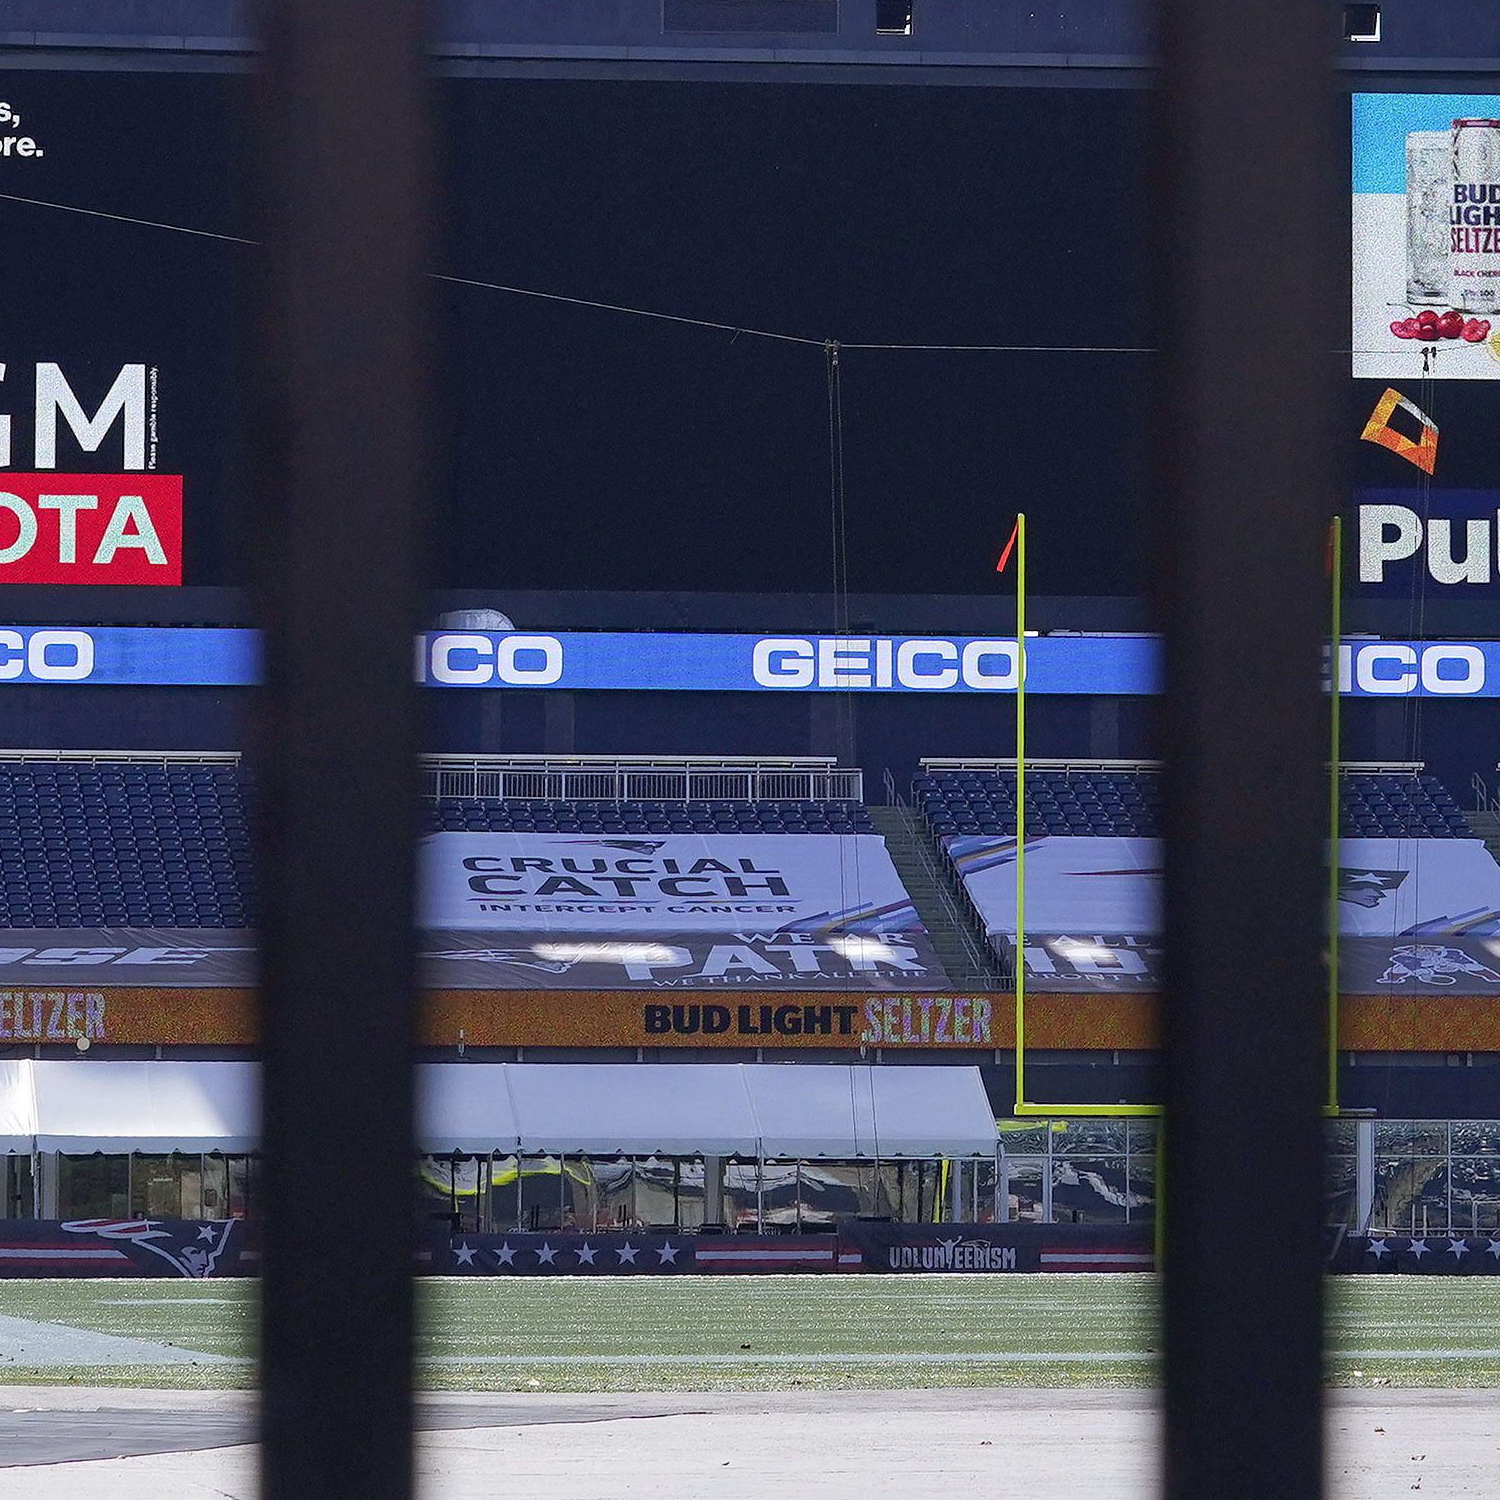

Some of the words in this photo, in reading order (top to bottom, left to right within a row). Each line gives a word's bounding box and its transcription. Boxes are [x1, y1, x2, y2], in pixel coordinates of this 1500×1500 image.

[414, 635, 563, 684] ICO
[752, 638, 1027, 689] GEICO
[1322, 645, 1486, 694] ICO
[462, 856, 781, 875] CRUCIAL
[466, 875, 790, 897] CATCH
[478, 903, 654, 914] INTERCEPT
[666, 904, 796, 914] CANCER
[643, 1005, 732, 1034] BUD
[736, 1005, 857, 1034] LIGHT
[862, 997, 993, 1043] SELTZER
